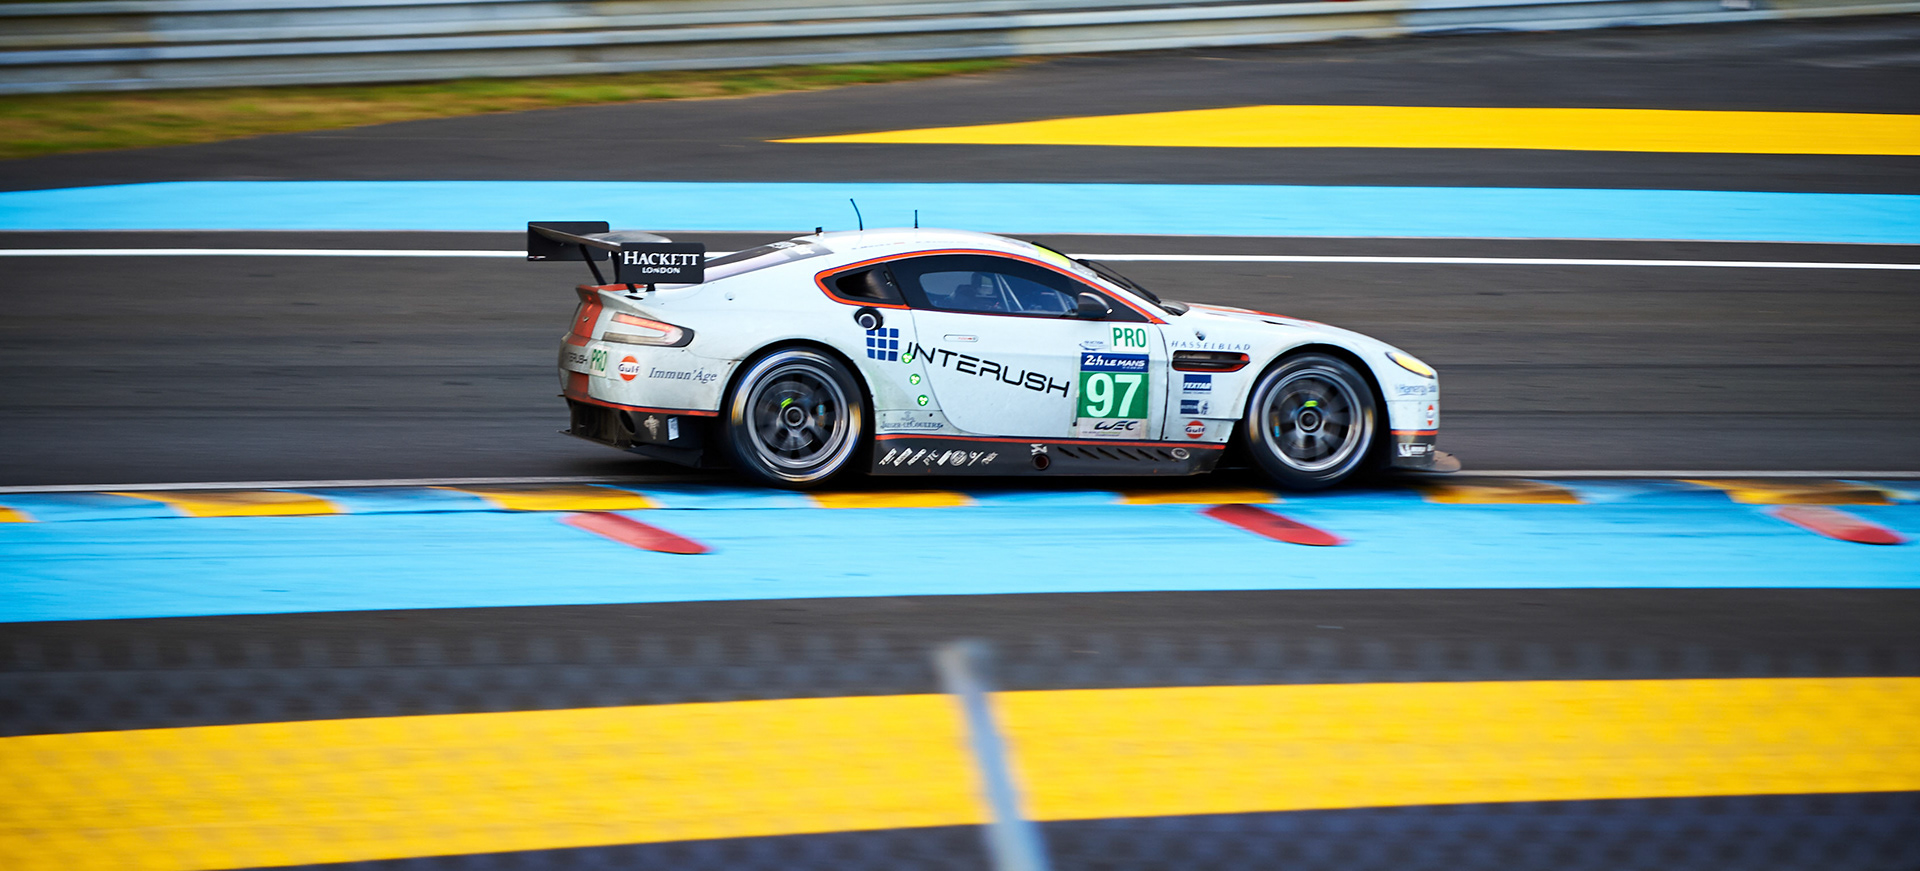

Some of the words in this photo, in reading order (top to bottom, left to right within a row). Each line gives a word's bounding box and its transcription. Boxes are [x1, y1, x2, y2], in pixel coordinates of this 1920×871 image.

[623, 250, 700, 266] HACKETT
[1112, 327, 1147, 348] PRO
[1171, 341, 1251, 350] HASSELBLAD
[590, 349, 608, 372] PRO
[618, 363, 641, 373] Gulf
[1117, 359, 1146, 367] MANS
[906, 342, 1070, 398] INTERUSH
[1086, 373, 1143, 418] 97
[1094, 420, 1138, 431] WEC
